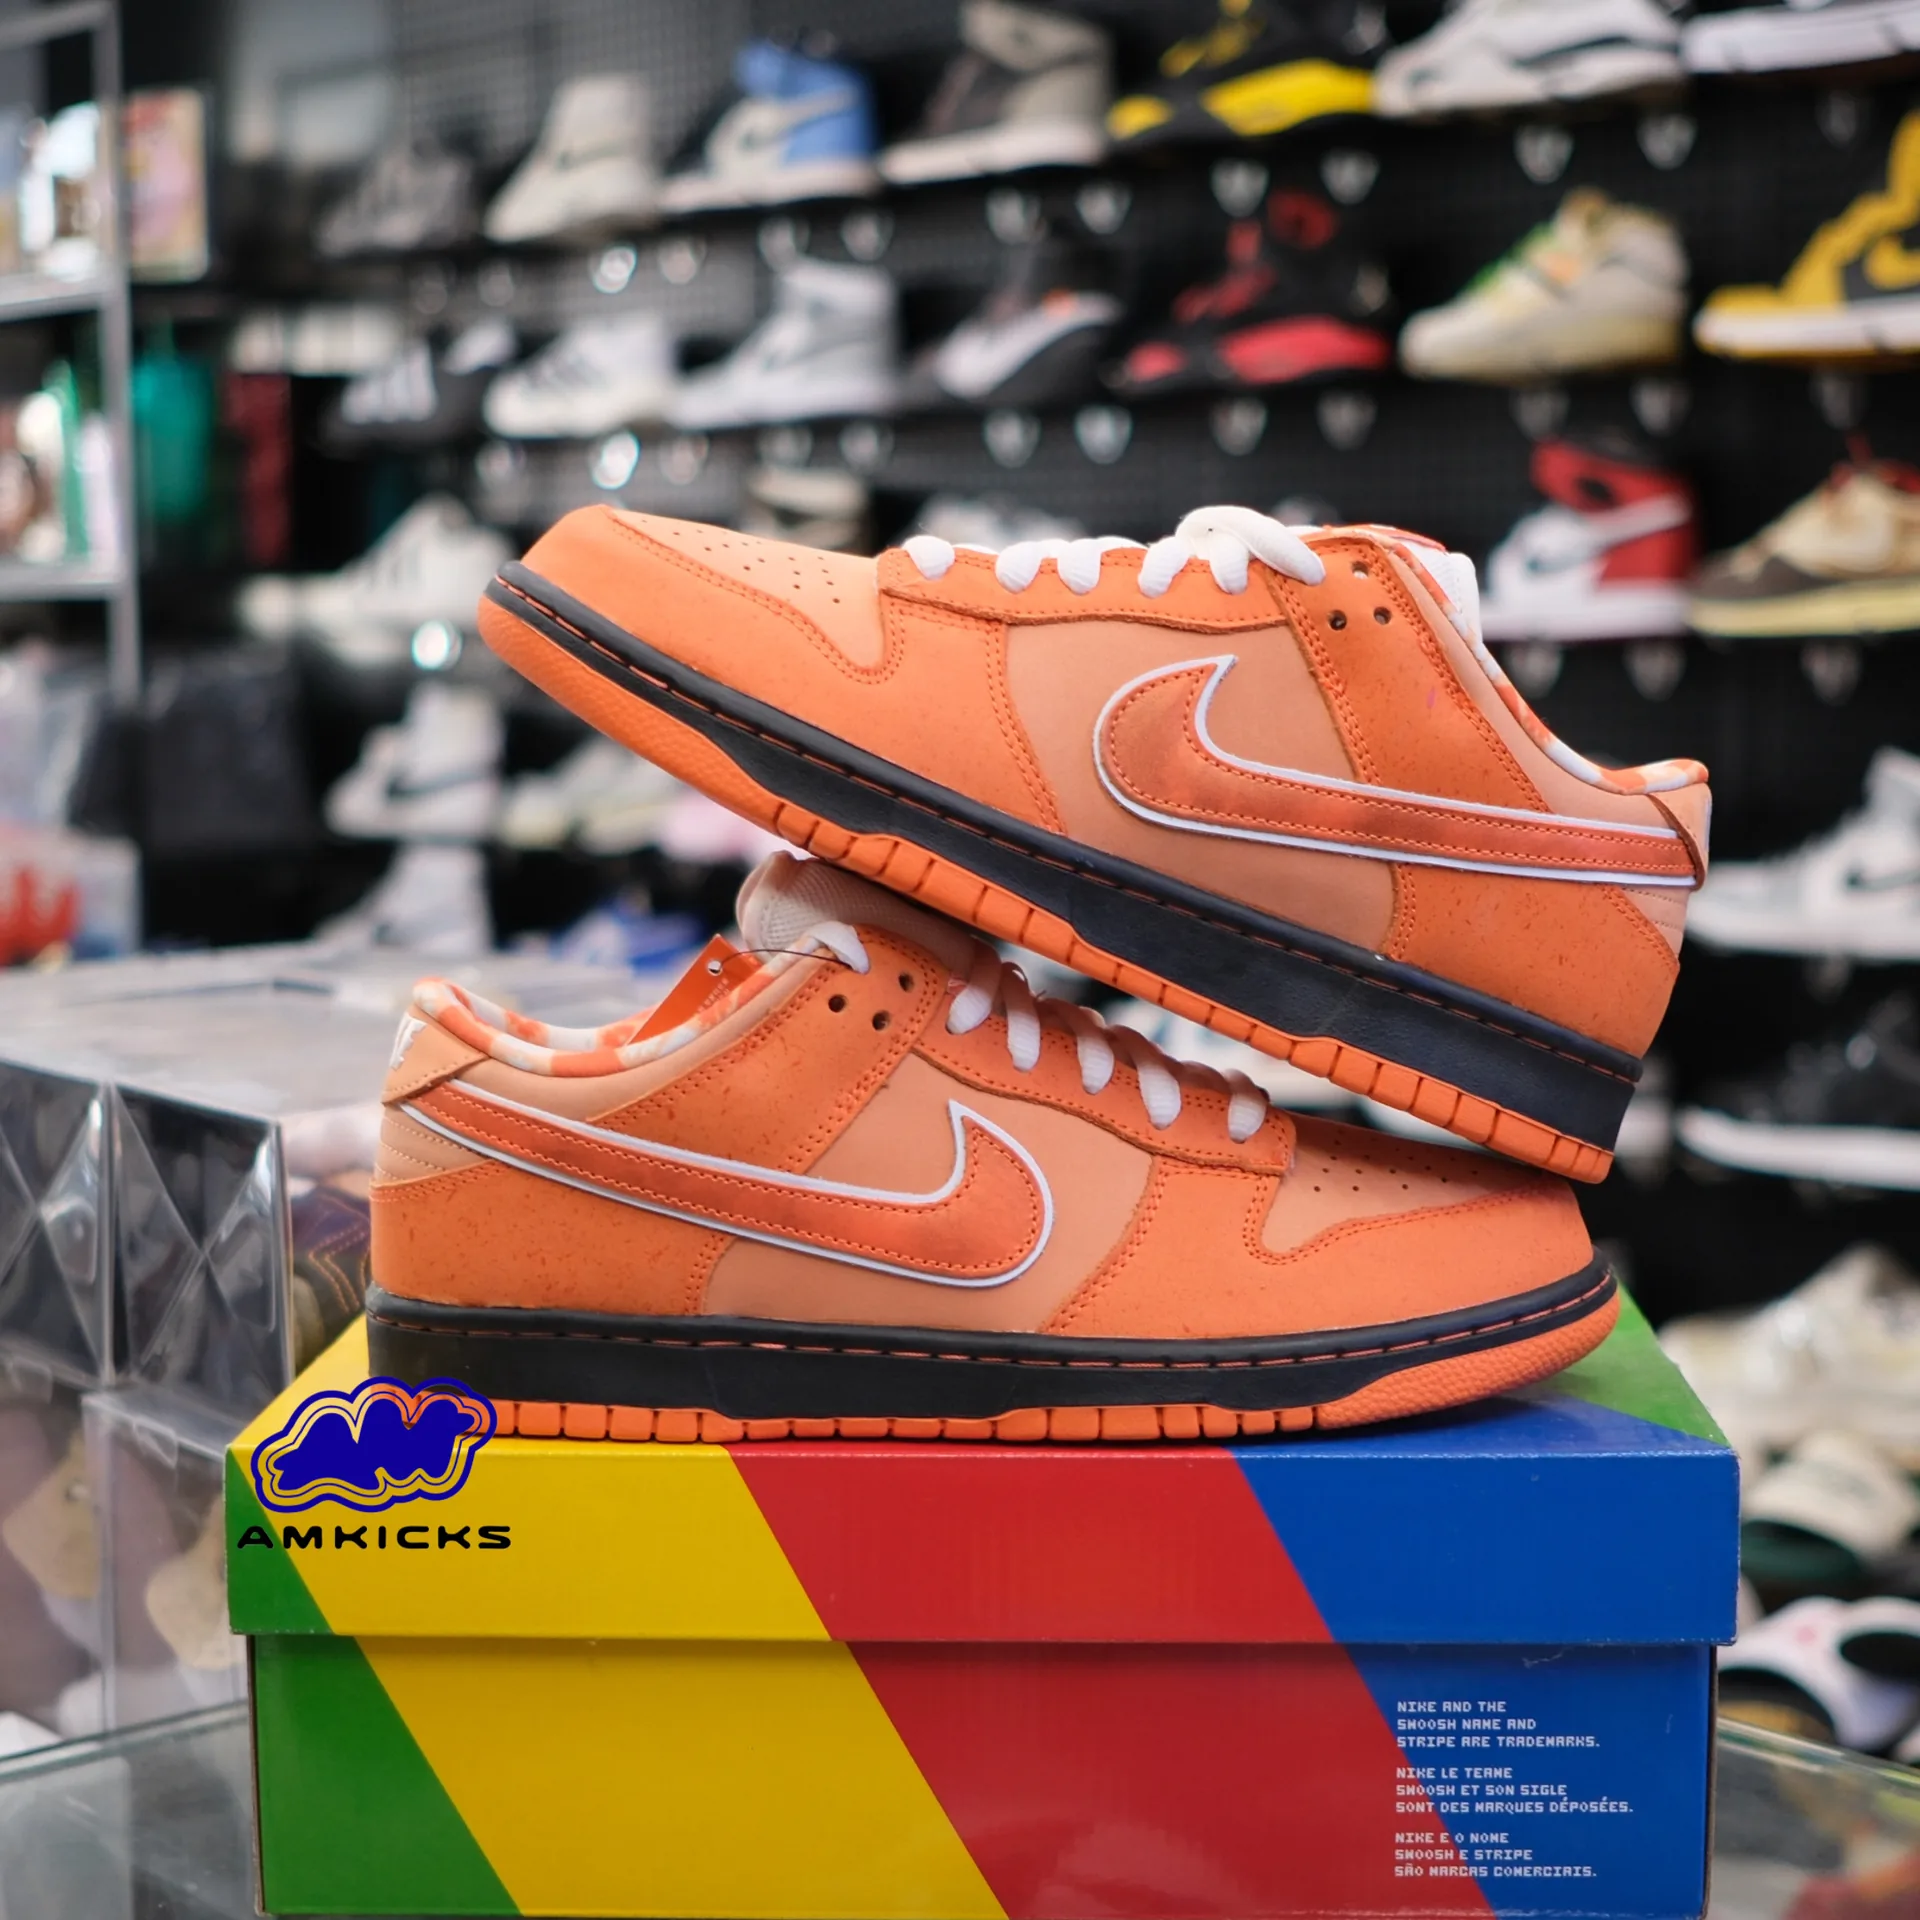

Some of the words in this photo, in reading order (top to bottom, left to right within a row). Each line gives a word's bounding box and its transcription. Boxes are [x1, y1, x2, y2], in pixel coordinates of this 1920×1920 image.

[1397, 1701, 1437, 1714] NIKE
[1442, 1701, 1472, 1714] AND
[1478, 1701, 1506, 1714] THE
[1397, 1718, 1456, 1730] SWOOSH
[1462, 1718, 1501, 1730] NAME
[1507, 1718, 1537, 1730] AND
[1397, 1736, 1456, 1748] STRIPE
[1461, 1736, 1490, 1748] ARE
[1496, 1736, 1601, 1748] TRADEMARKS.
[1396, 1767, 1436, 1779] NIKE
[1441, 1767, 1458, 1779] LE
[1396, 1784, 1455, 1796] SWOOSH
[1460, 1784, 1480, 1796] ET
[1485, 1784, 1515, 1796] SON
[1520, 1784, 1567, 1796] SIGLE
[1396, 1801, 1435, 1813] SONT
[1440, 1801, 1469, 1813] DES
[1474, 1801, 1544, 1815] MARQUES
[1549, 1796, 1634, 1813] DÉPOSÉES.
[1395, 1832, 1434, 1844] NIKE
[1440, 1832, 1449, 1844] E
[1455, 1832, 1464, 1844] O
[1470, 1832, 1509, 1844] NOME
[1395, 1849, 1454, 1861] SWOOSH
[1459, 1849, 1469, 1861] E
[1474, 1849, 1533, 1861] STRIPE
[1395, 1863, 1424, 1878] SÃO
[1429, 1866, 1488, 1878] MARCAS
[1493, 1866, 1597, 1878] COMERCIAIS.
